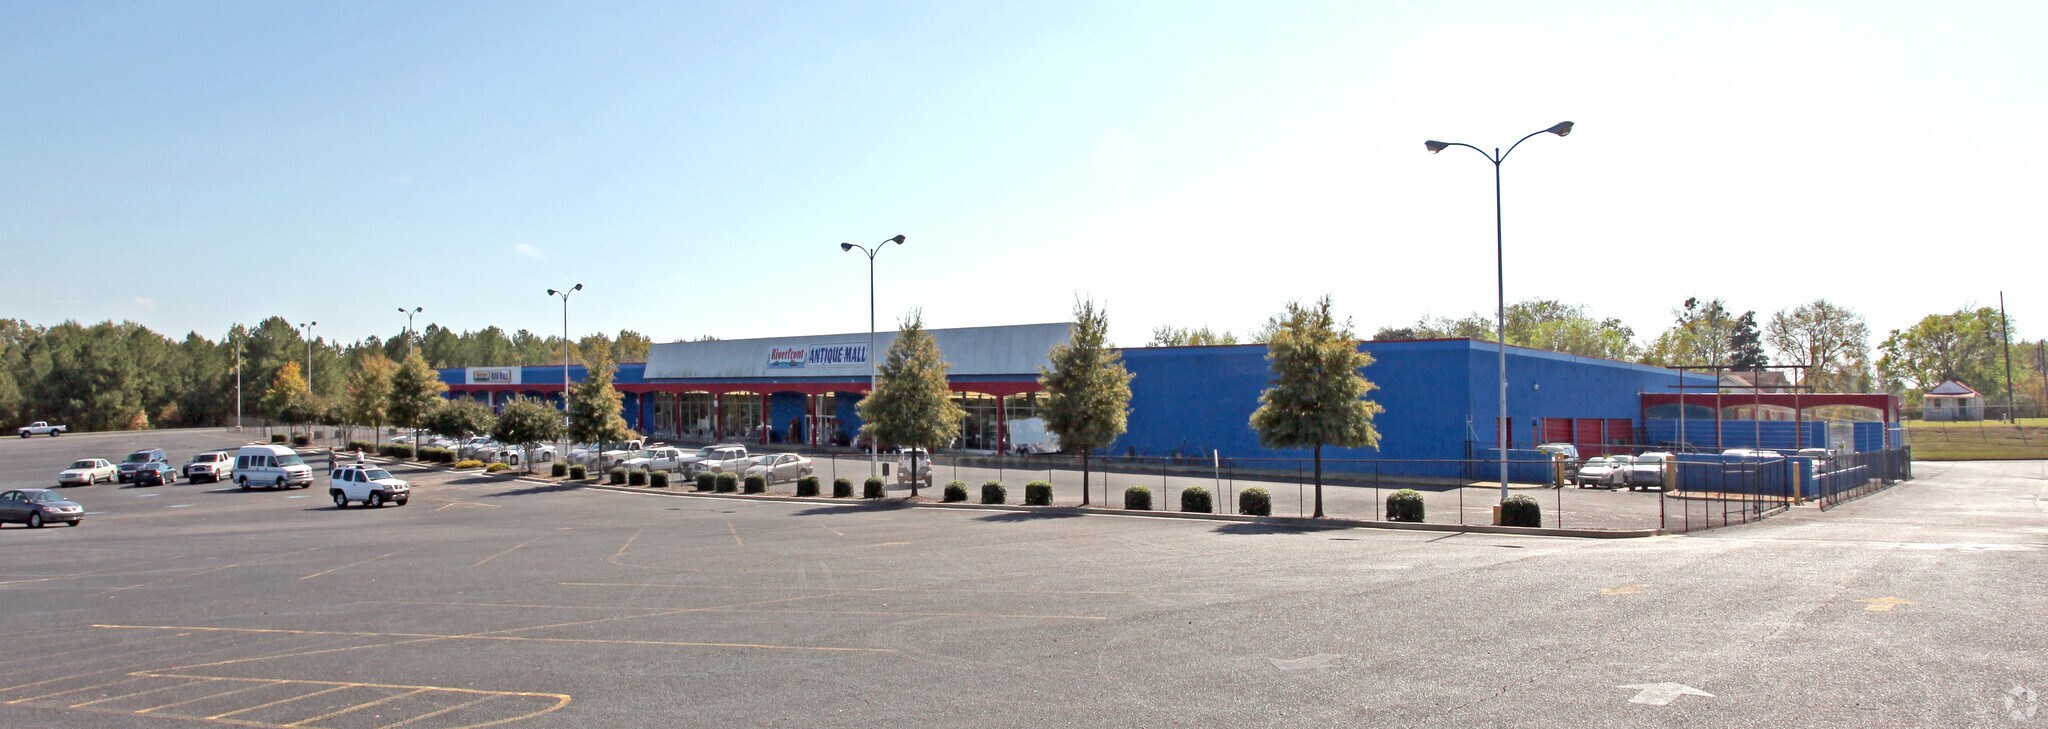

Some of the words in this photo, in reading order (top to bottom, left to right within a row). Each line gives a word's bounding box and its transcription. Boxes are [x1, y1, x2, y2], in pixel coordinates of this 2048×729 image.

[771, 348, 804, 360] Riverfront
[808, 347, 842, 364] ANTIQUE
[844, 346, 865, 362] MALL
